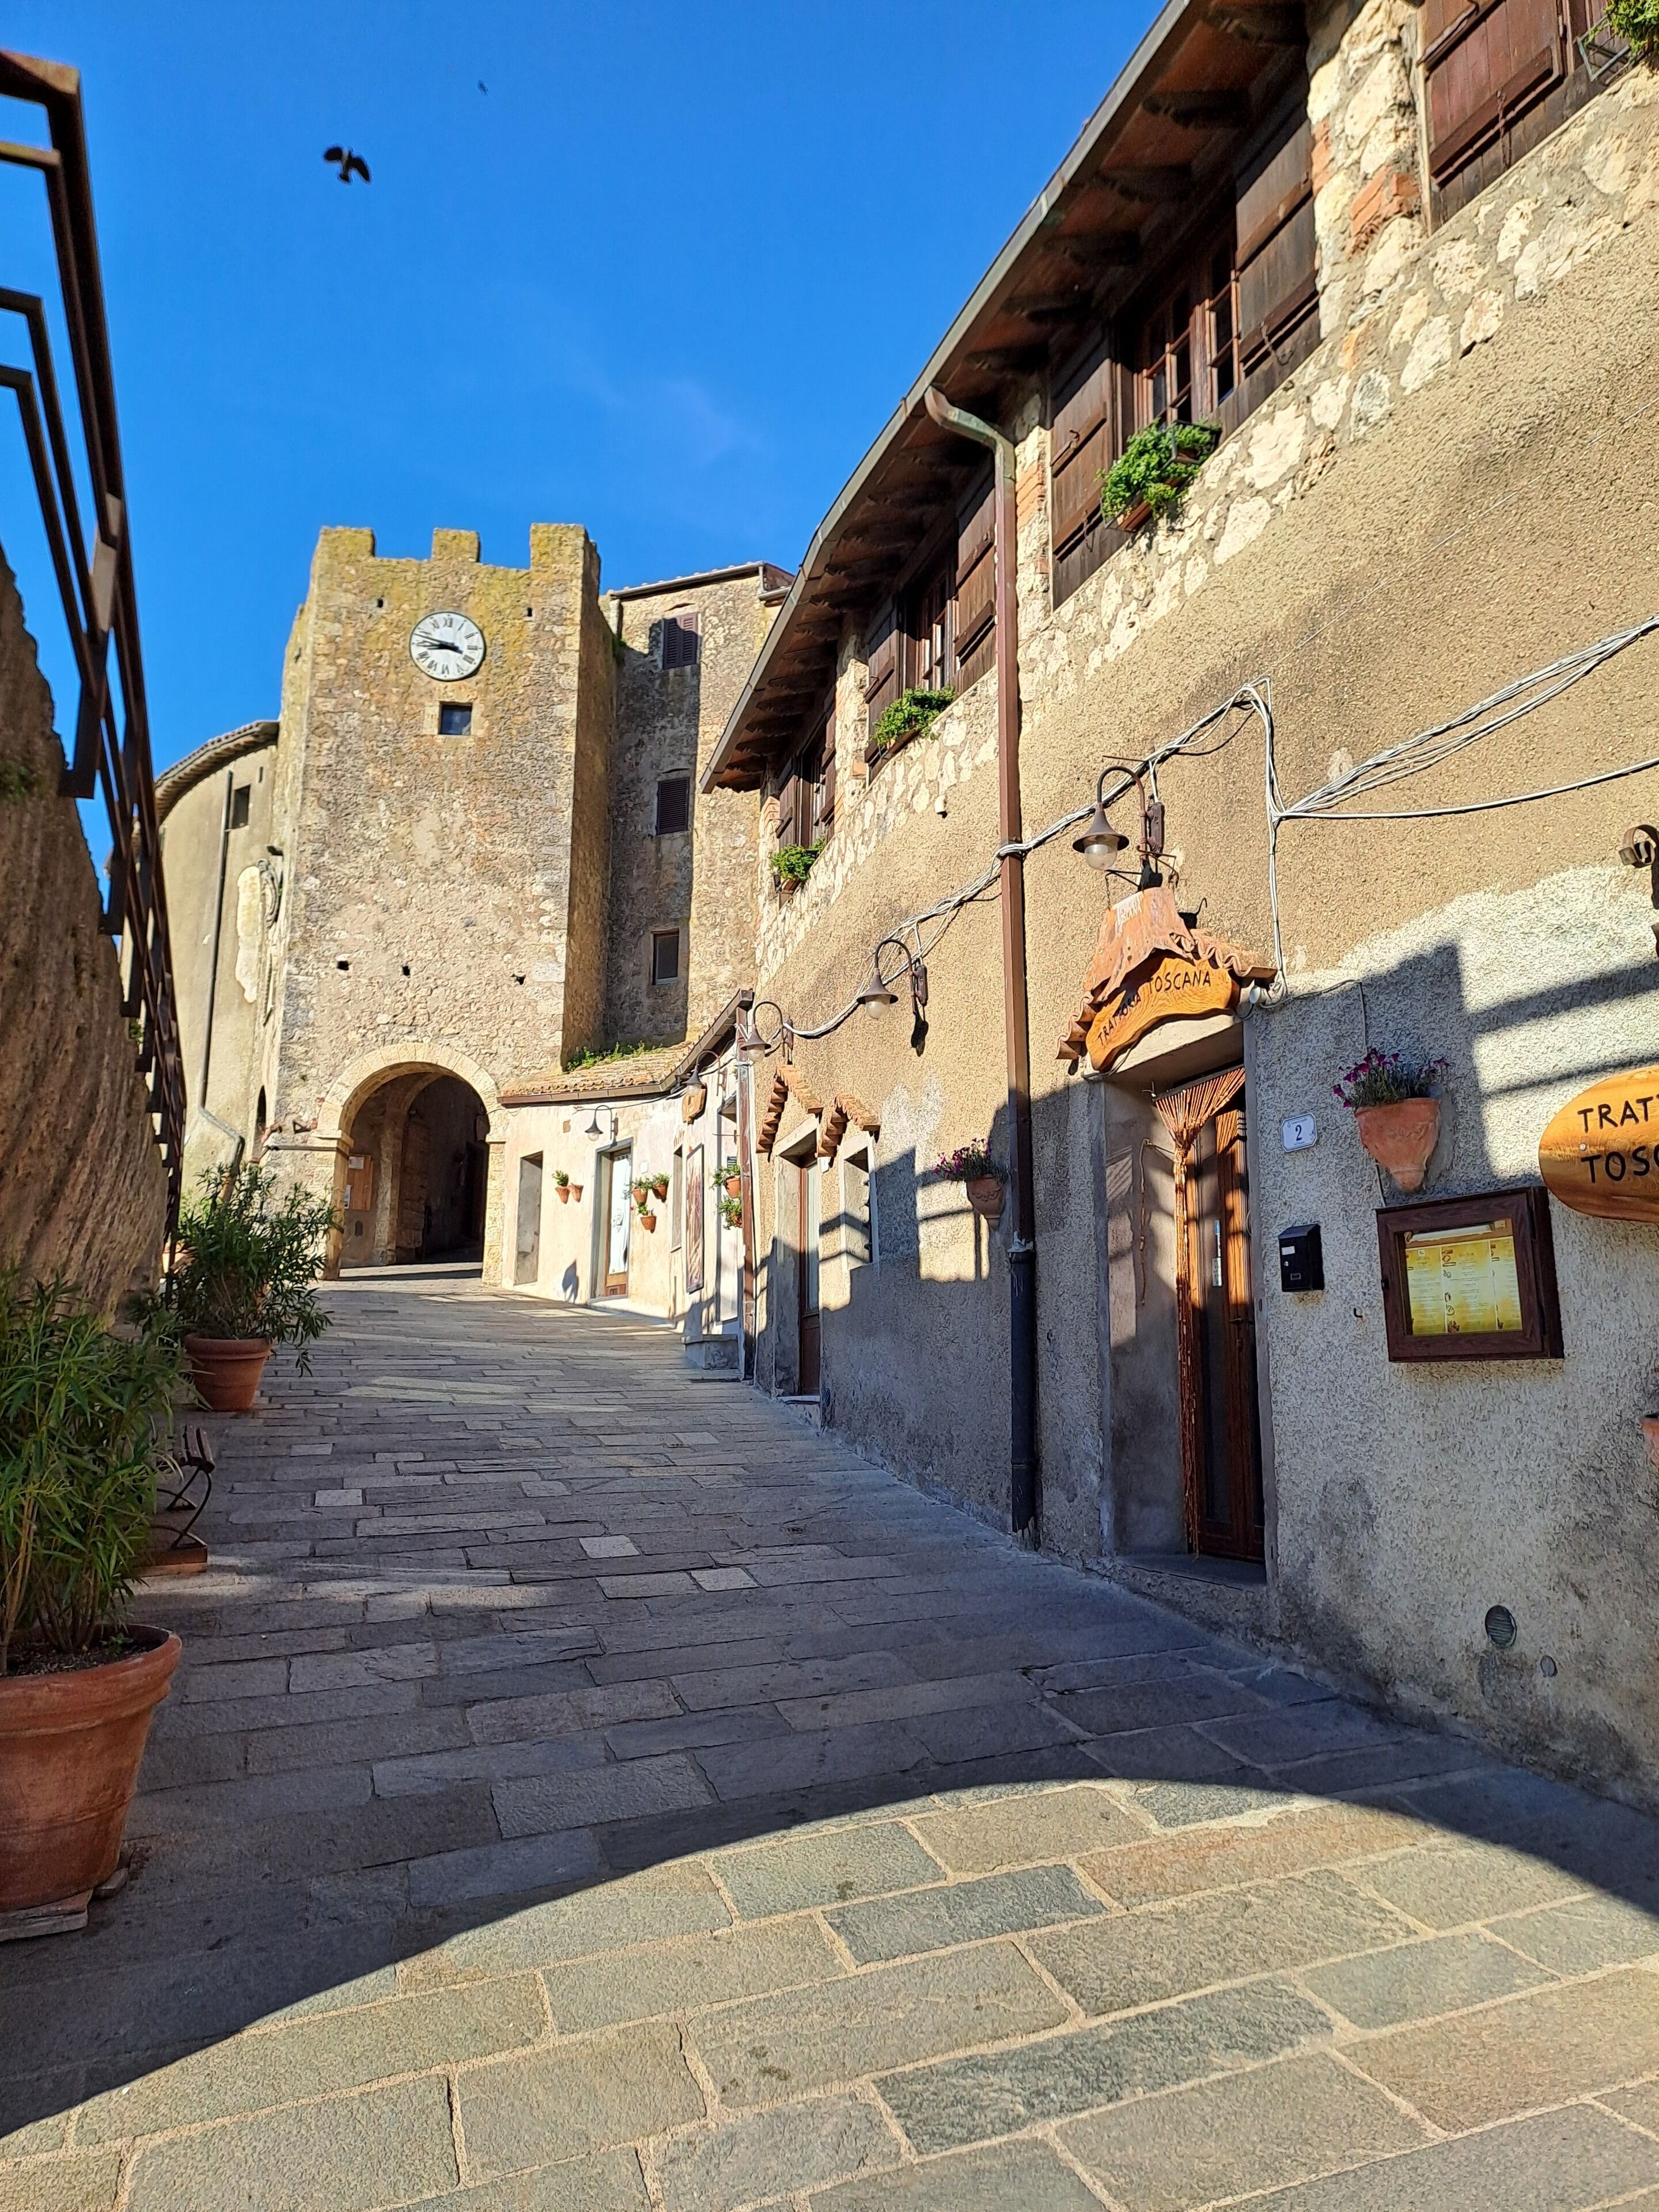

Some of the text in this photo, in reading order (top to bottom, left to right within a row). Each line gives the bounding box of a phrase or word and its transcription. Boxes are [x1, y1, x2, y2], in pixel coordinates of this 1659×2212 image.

[1148, 970, 1211, 995] TOSCANA
[1577, 1093, 1659, 1134] TRAT
[1295, 1124, 1302, 1141] 2
